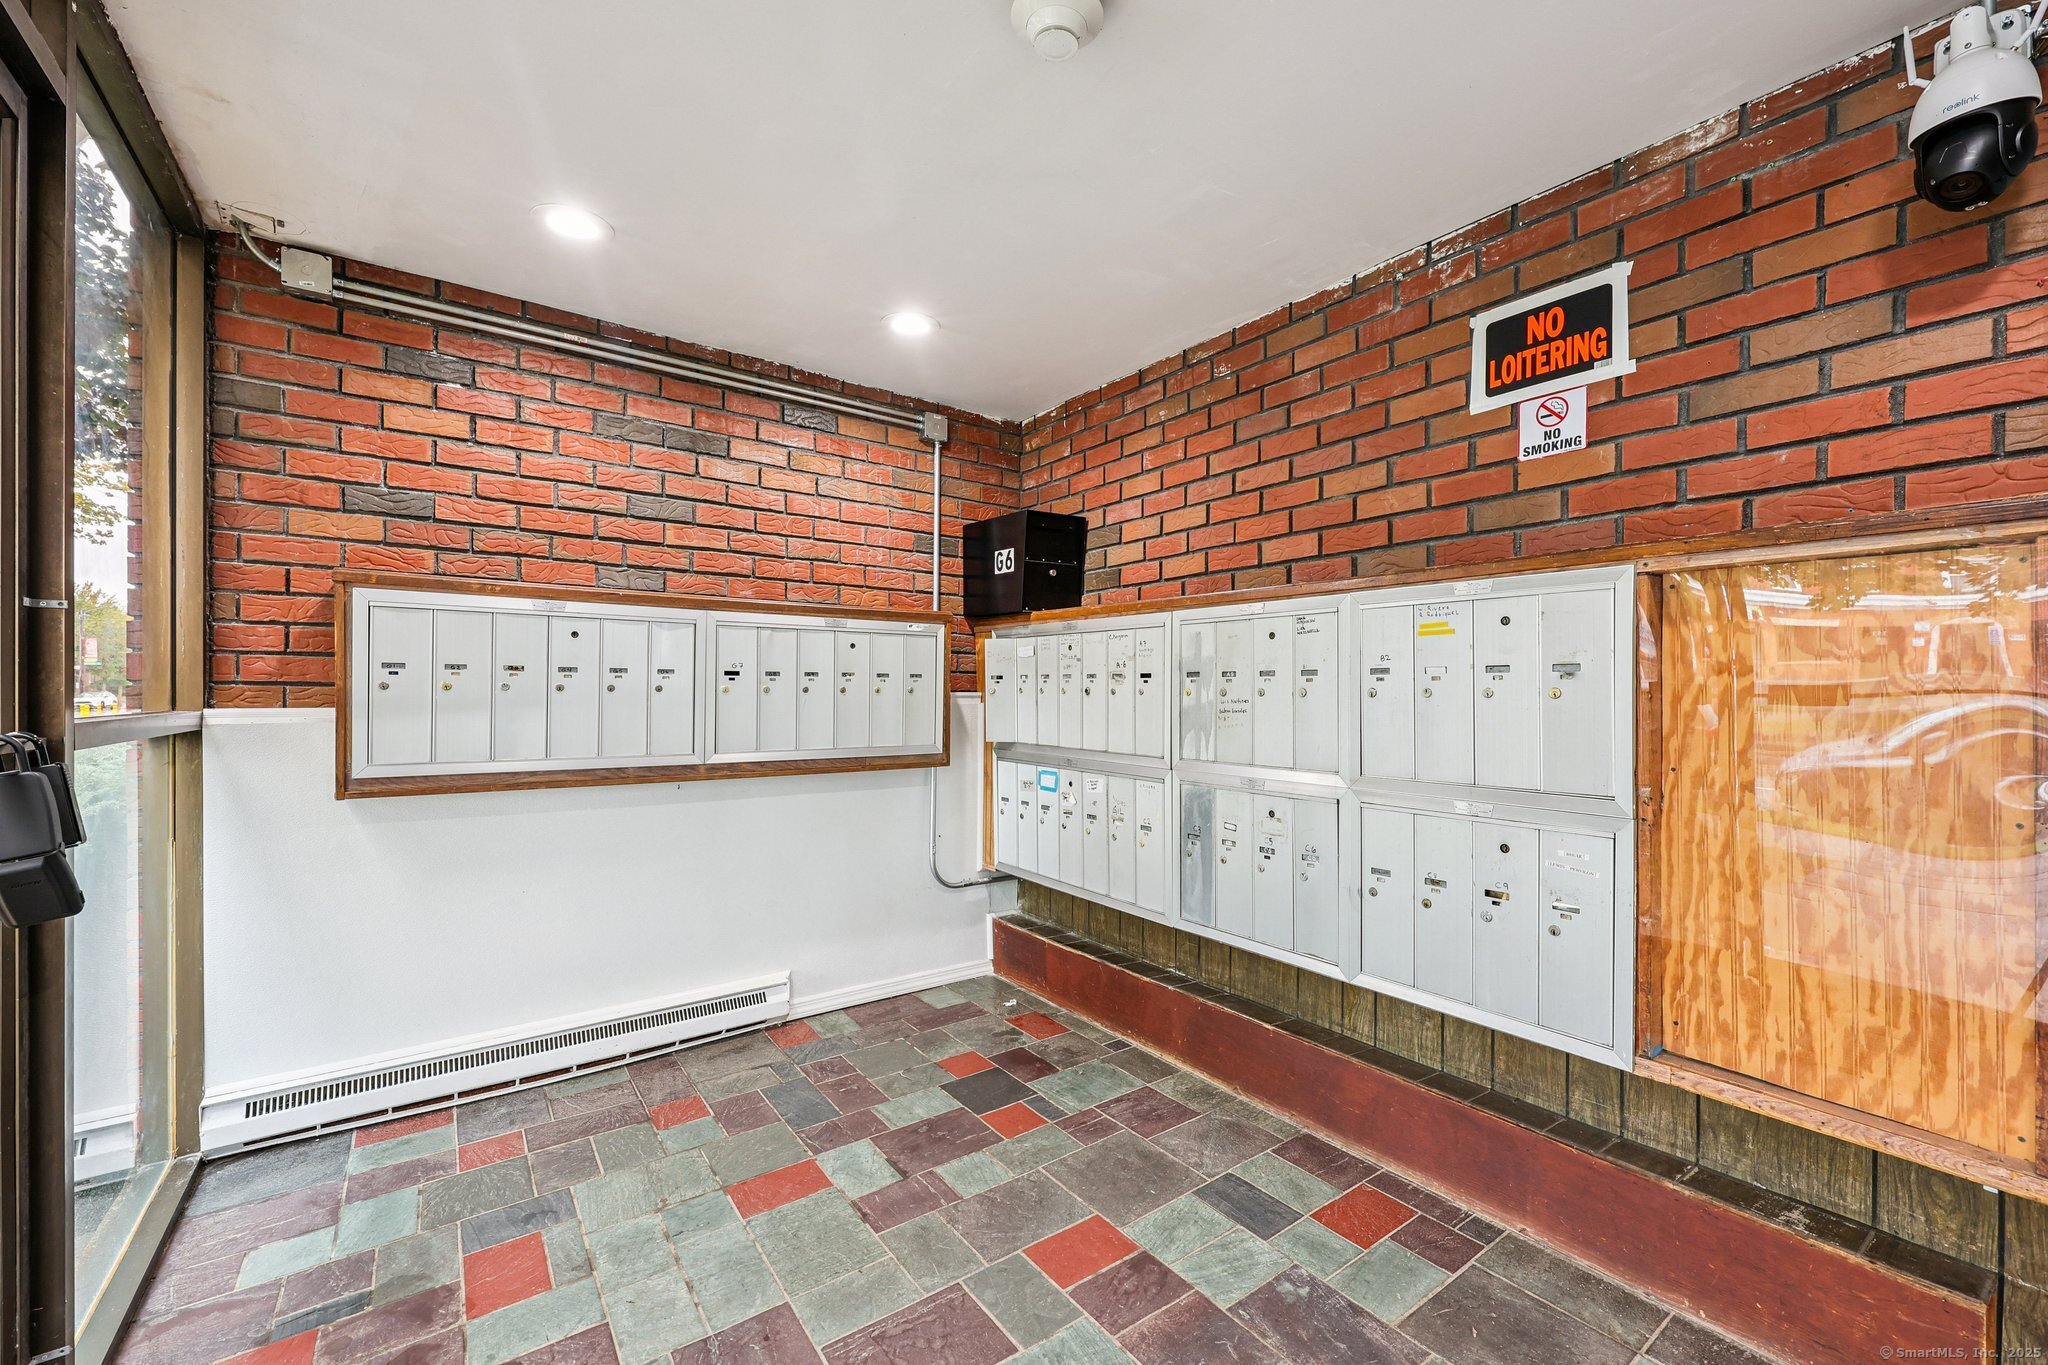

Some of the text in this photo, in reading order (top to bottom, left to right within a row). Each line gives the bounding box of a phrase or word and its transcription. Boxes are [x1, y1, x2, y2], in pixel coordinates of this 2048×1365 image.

[1942, 93, 1981, 115] reolink
[1527, 306, 1565, 345] NO
[1489, 326, 1608, 389] LOITERING
[1543, 427, 1561, 442] NO
[1522, 435, 1583, 458] SMOKING
[995, 549, 1014, 573] G6
[1304, 843, 1317, 854] C6
[1494, 881, 1509, 890] C9
